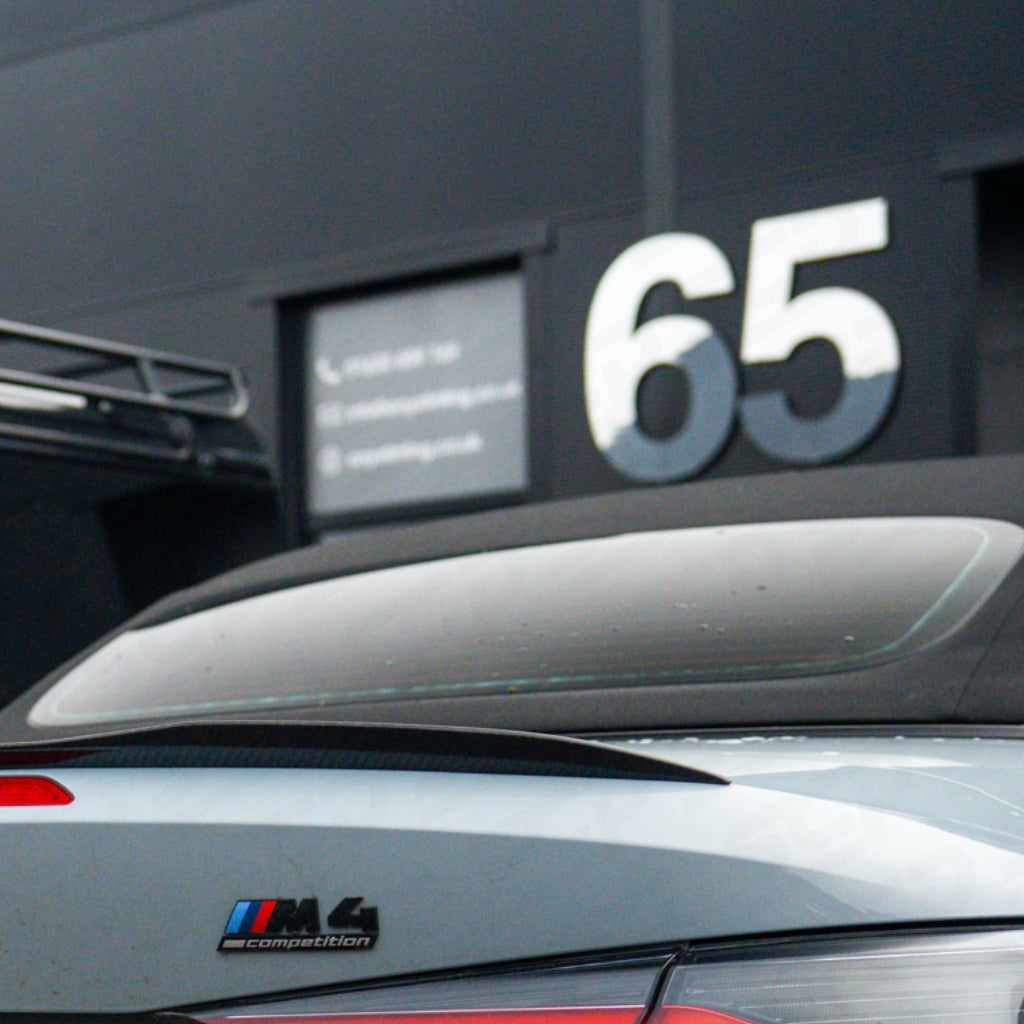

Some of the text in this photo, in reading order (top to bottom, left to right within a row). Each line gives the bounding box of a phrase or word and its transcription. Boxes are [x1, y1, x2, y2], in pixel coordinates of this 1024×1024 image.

[583, 197, 901, 483] 65
[267, 896, 379, 933] M4
[245, 935, 371, 950] competition
